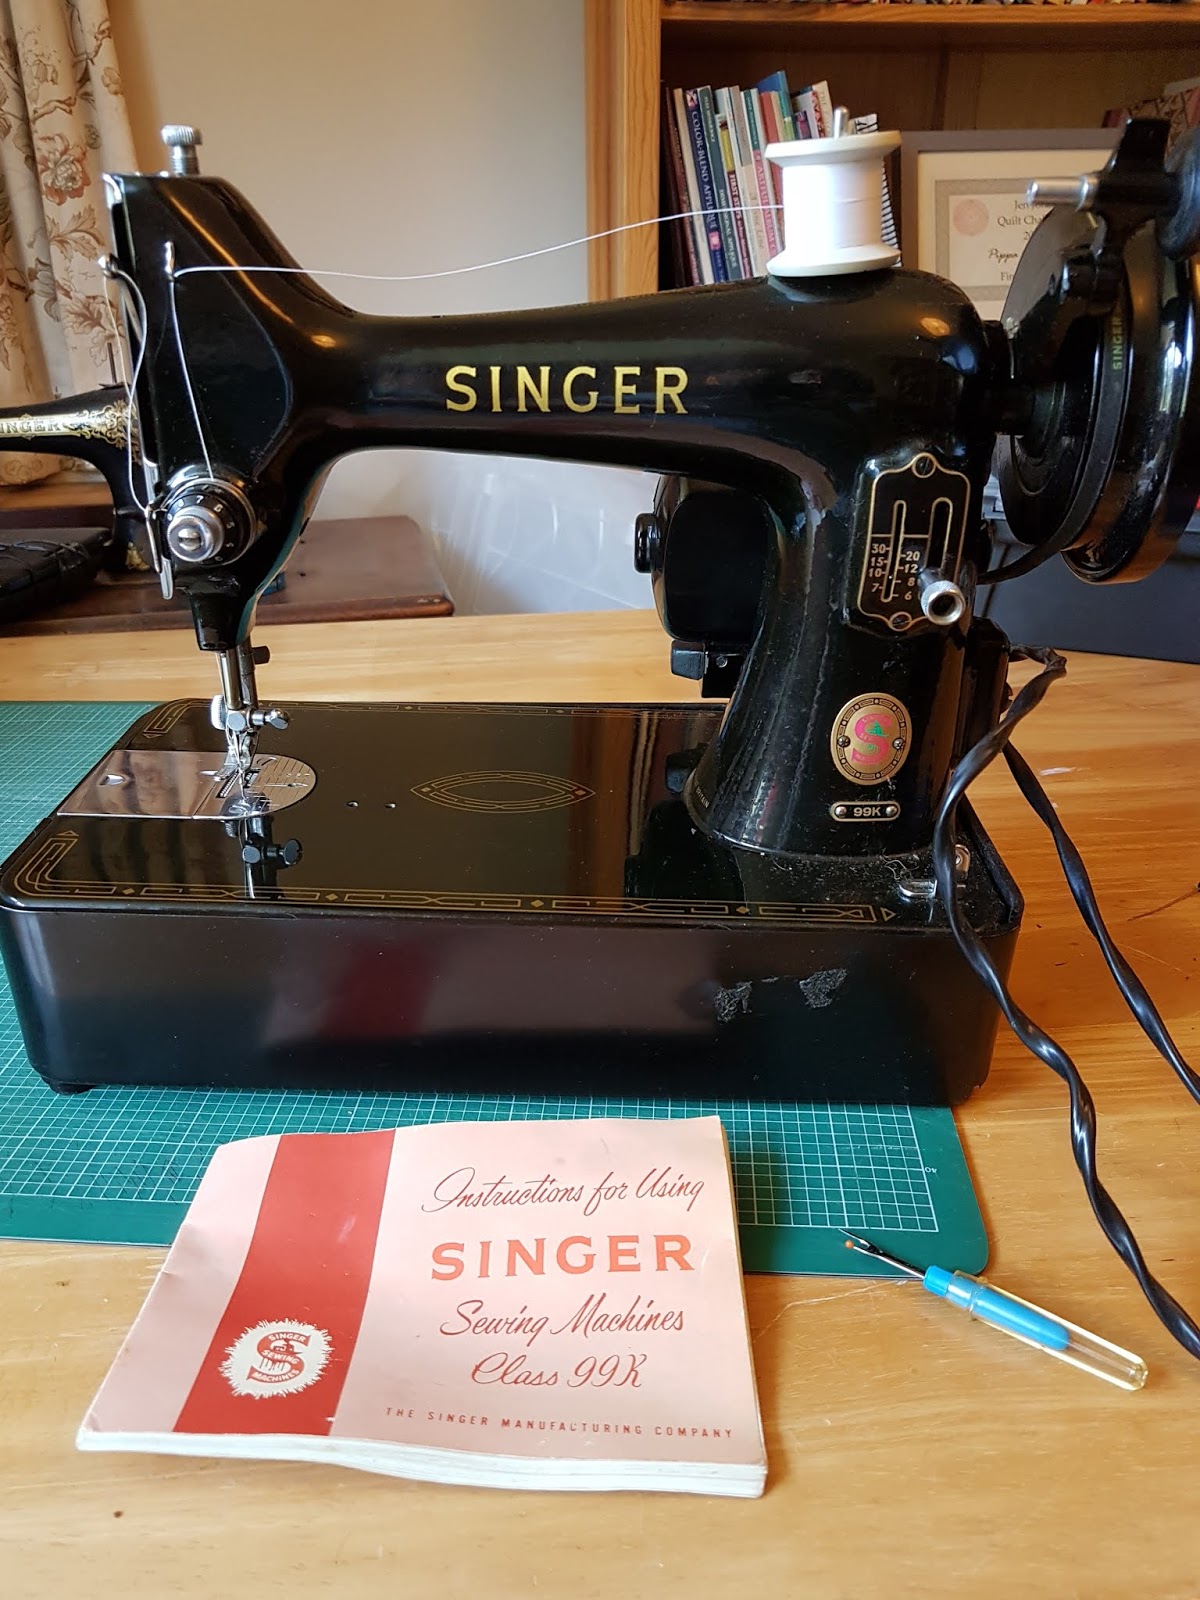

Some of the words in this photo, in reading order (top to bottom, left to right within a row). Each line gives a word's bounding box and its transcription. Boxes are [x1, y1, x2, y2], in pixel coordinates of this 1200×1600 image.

[691, 110, 709, 182] COLOR-BLEND
[728, 173, 738, 195] FIRST
[718, 188, 732, 235] DIMESIONAL
[732, 196, 742, 219] STPS
[997, 216, 1021, 227] Quilt
[445, 365, 689, 414] SINGER
[196, 495, 204, 504] 7
[871, 543, 886, 554] 30
[871, 556, 885, 567] 15
[905, 550, 921, 561] 20
[869, 568, 883, 578] 10
[904, 563, 919, 573] 12
[871, 582, 880, 592] 7
[907, 577, 916, 587] 8
[904, 591, 913, 601] 6
[853, 807, 881, 817] 99K
[421, 1167, 584, 1213] Instructions
[583, 1171, 628, 1216] for
[635, 1167, 705, 1212] Using
[431, 1234, 695, 1281] SINGER
[440, 1299, 549, 1347] Sewing
[550, 1292, 684, 1338] Machines
[268, 1332, 307, 1343] SINGER
[261, 1349, 300, 1364] SEWING
[251, 1369, 300, 1382] MACHINES
[471, 1352, 559, 1387] Class
[566, 1353, 648, 1388] 99K
[385, 1407, 415, 1418] THE
[427, 1411, 489, 1426] SINGER
[501, 1418, 642, 1435] MANUFACTURING
[654, 1426, 732, 1438] COMPANY
